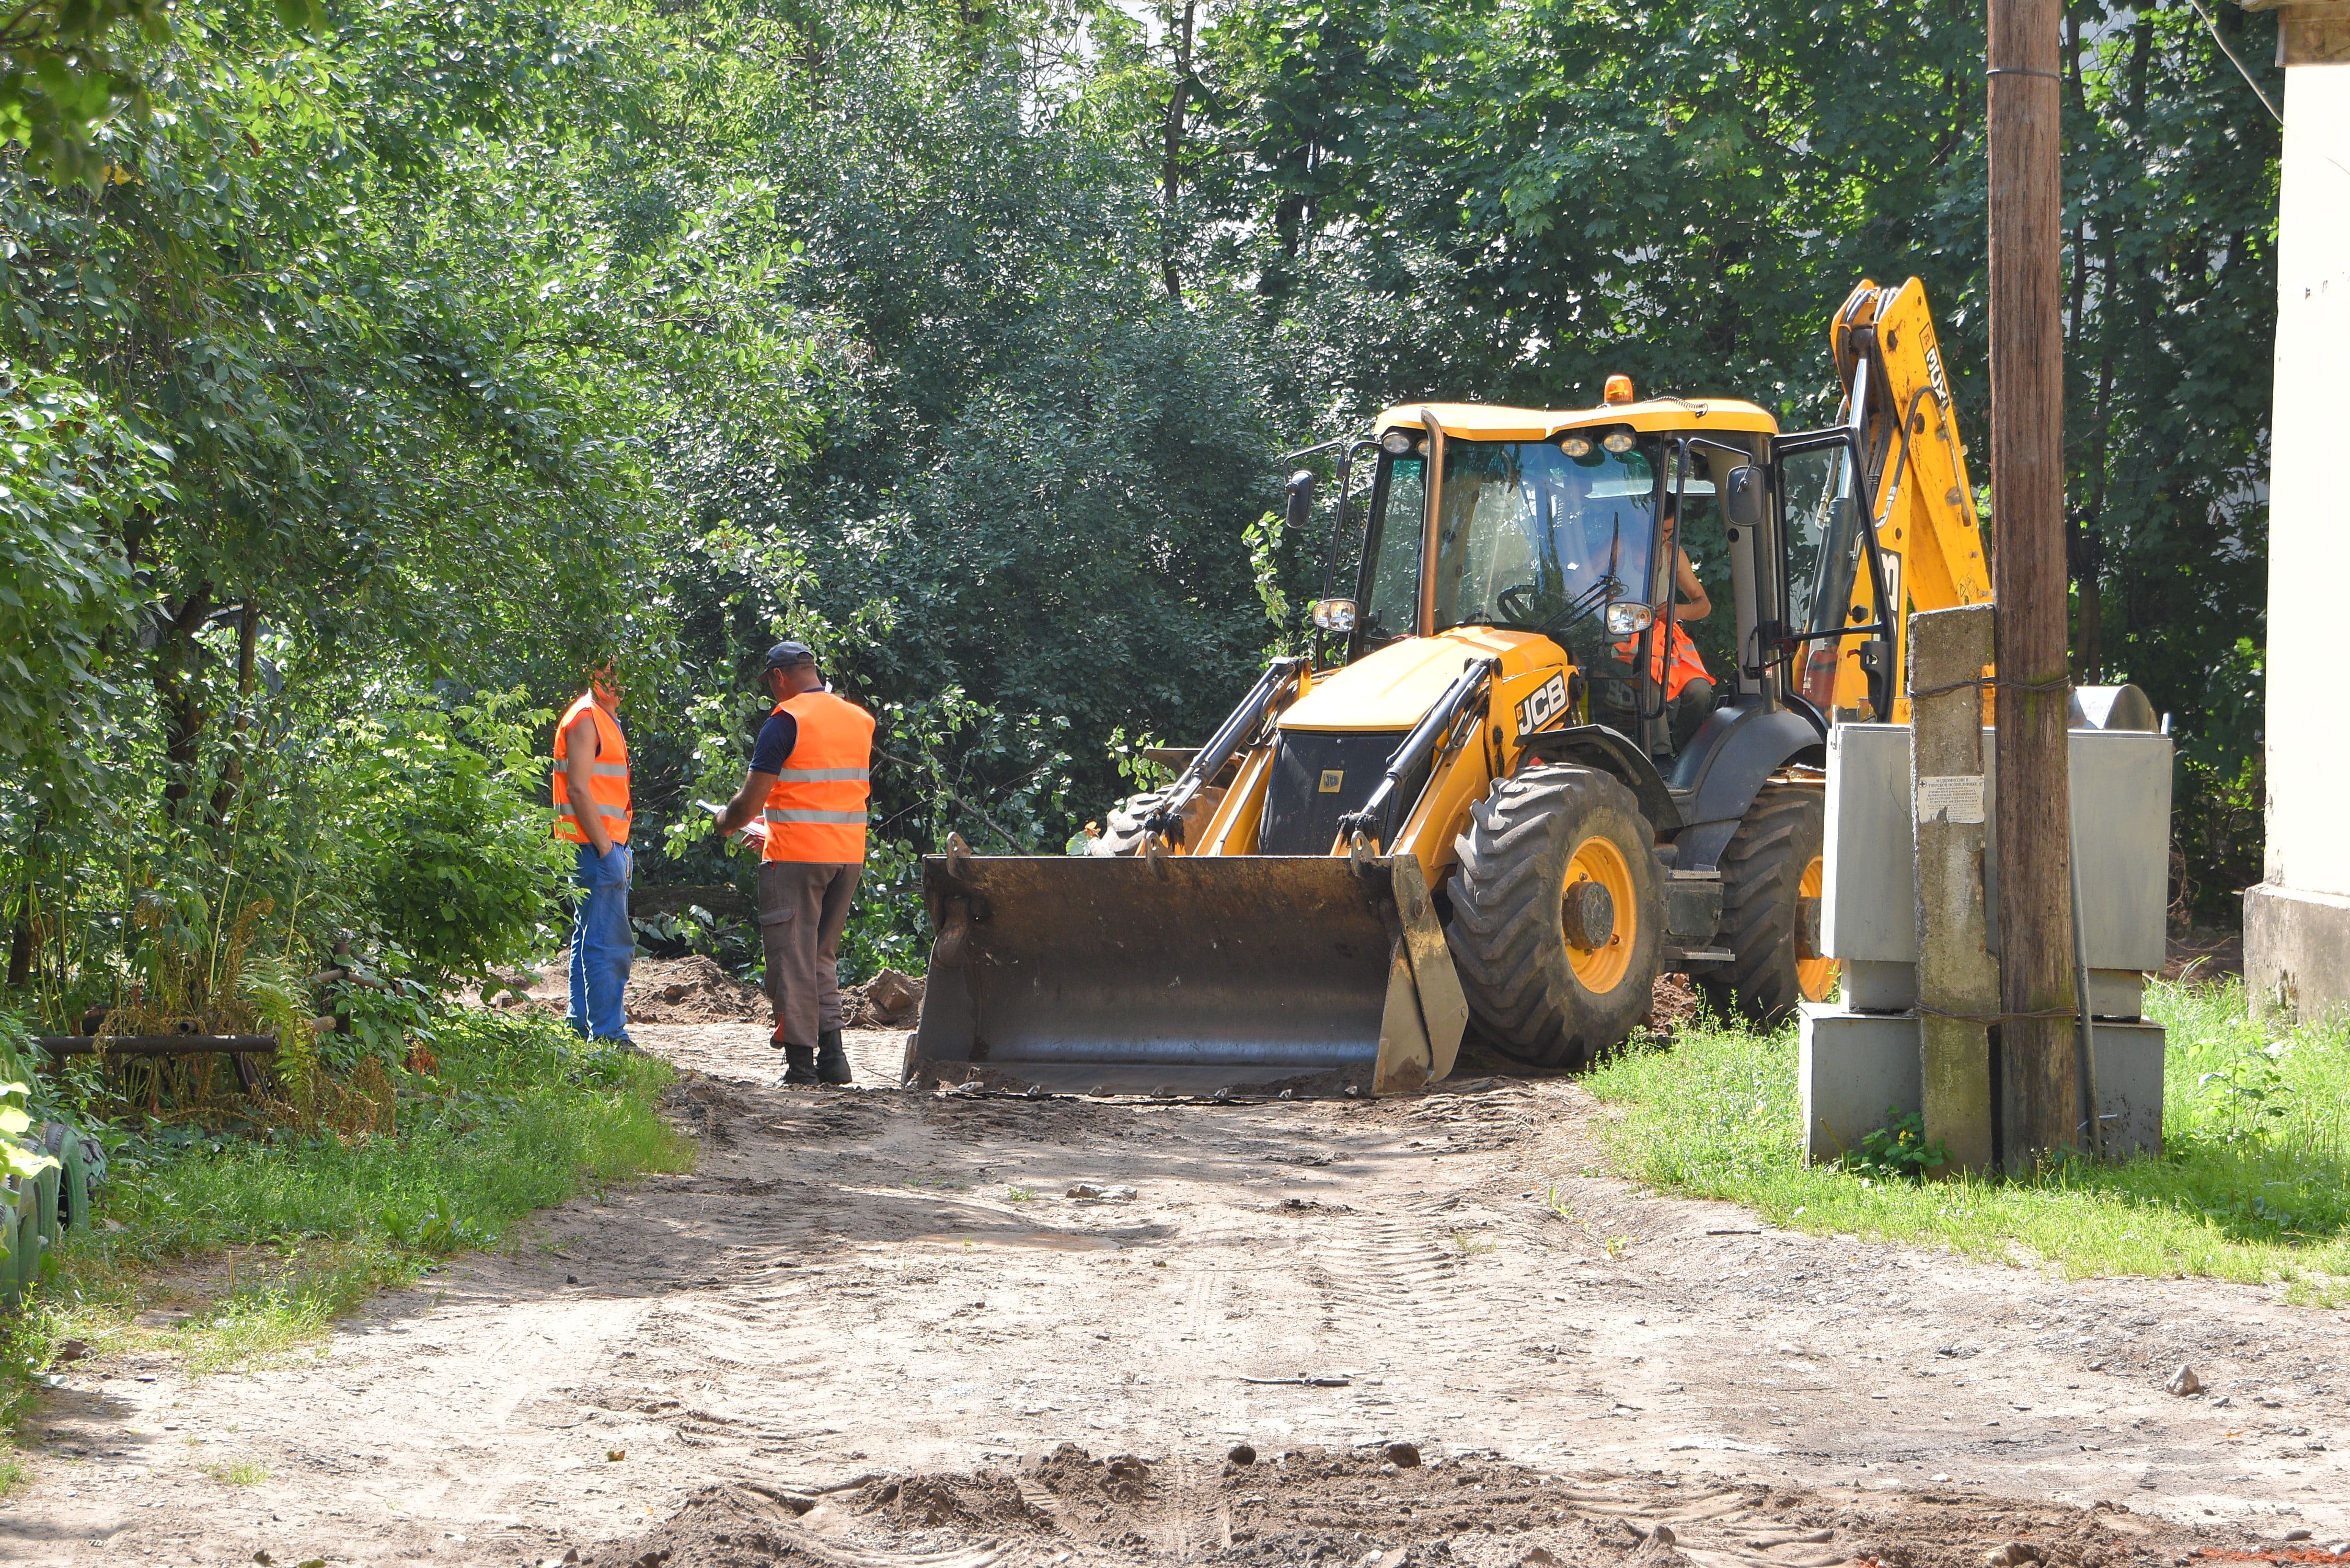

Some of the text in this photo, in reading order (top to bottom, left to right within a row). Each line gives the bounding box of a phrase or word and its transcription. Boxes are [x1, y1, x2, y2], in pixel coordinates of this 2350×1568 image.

[1926, 347, 1947, 401] 3CX
[1518, 675, 1565, 735] JCB
[1323, 773, 1339, 788] JCB
